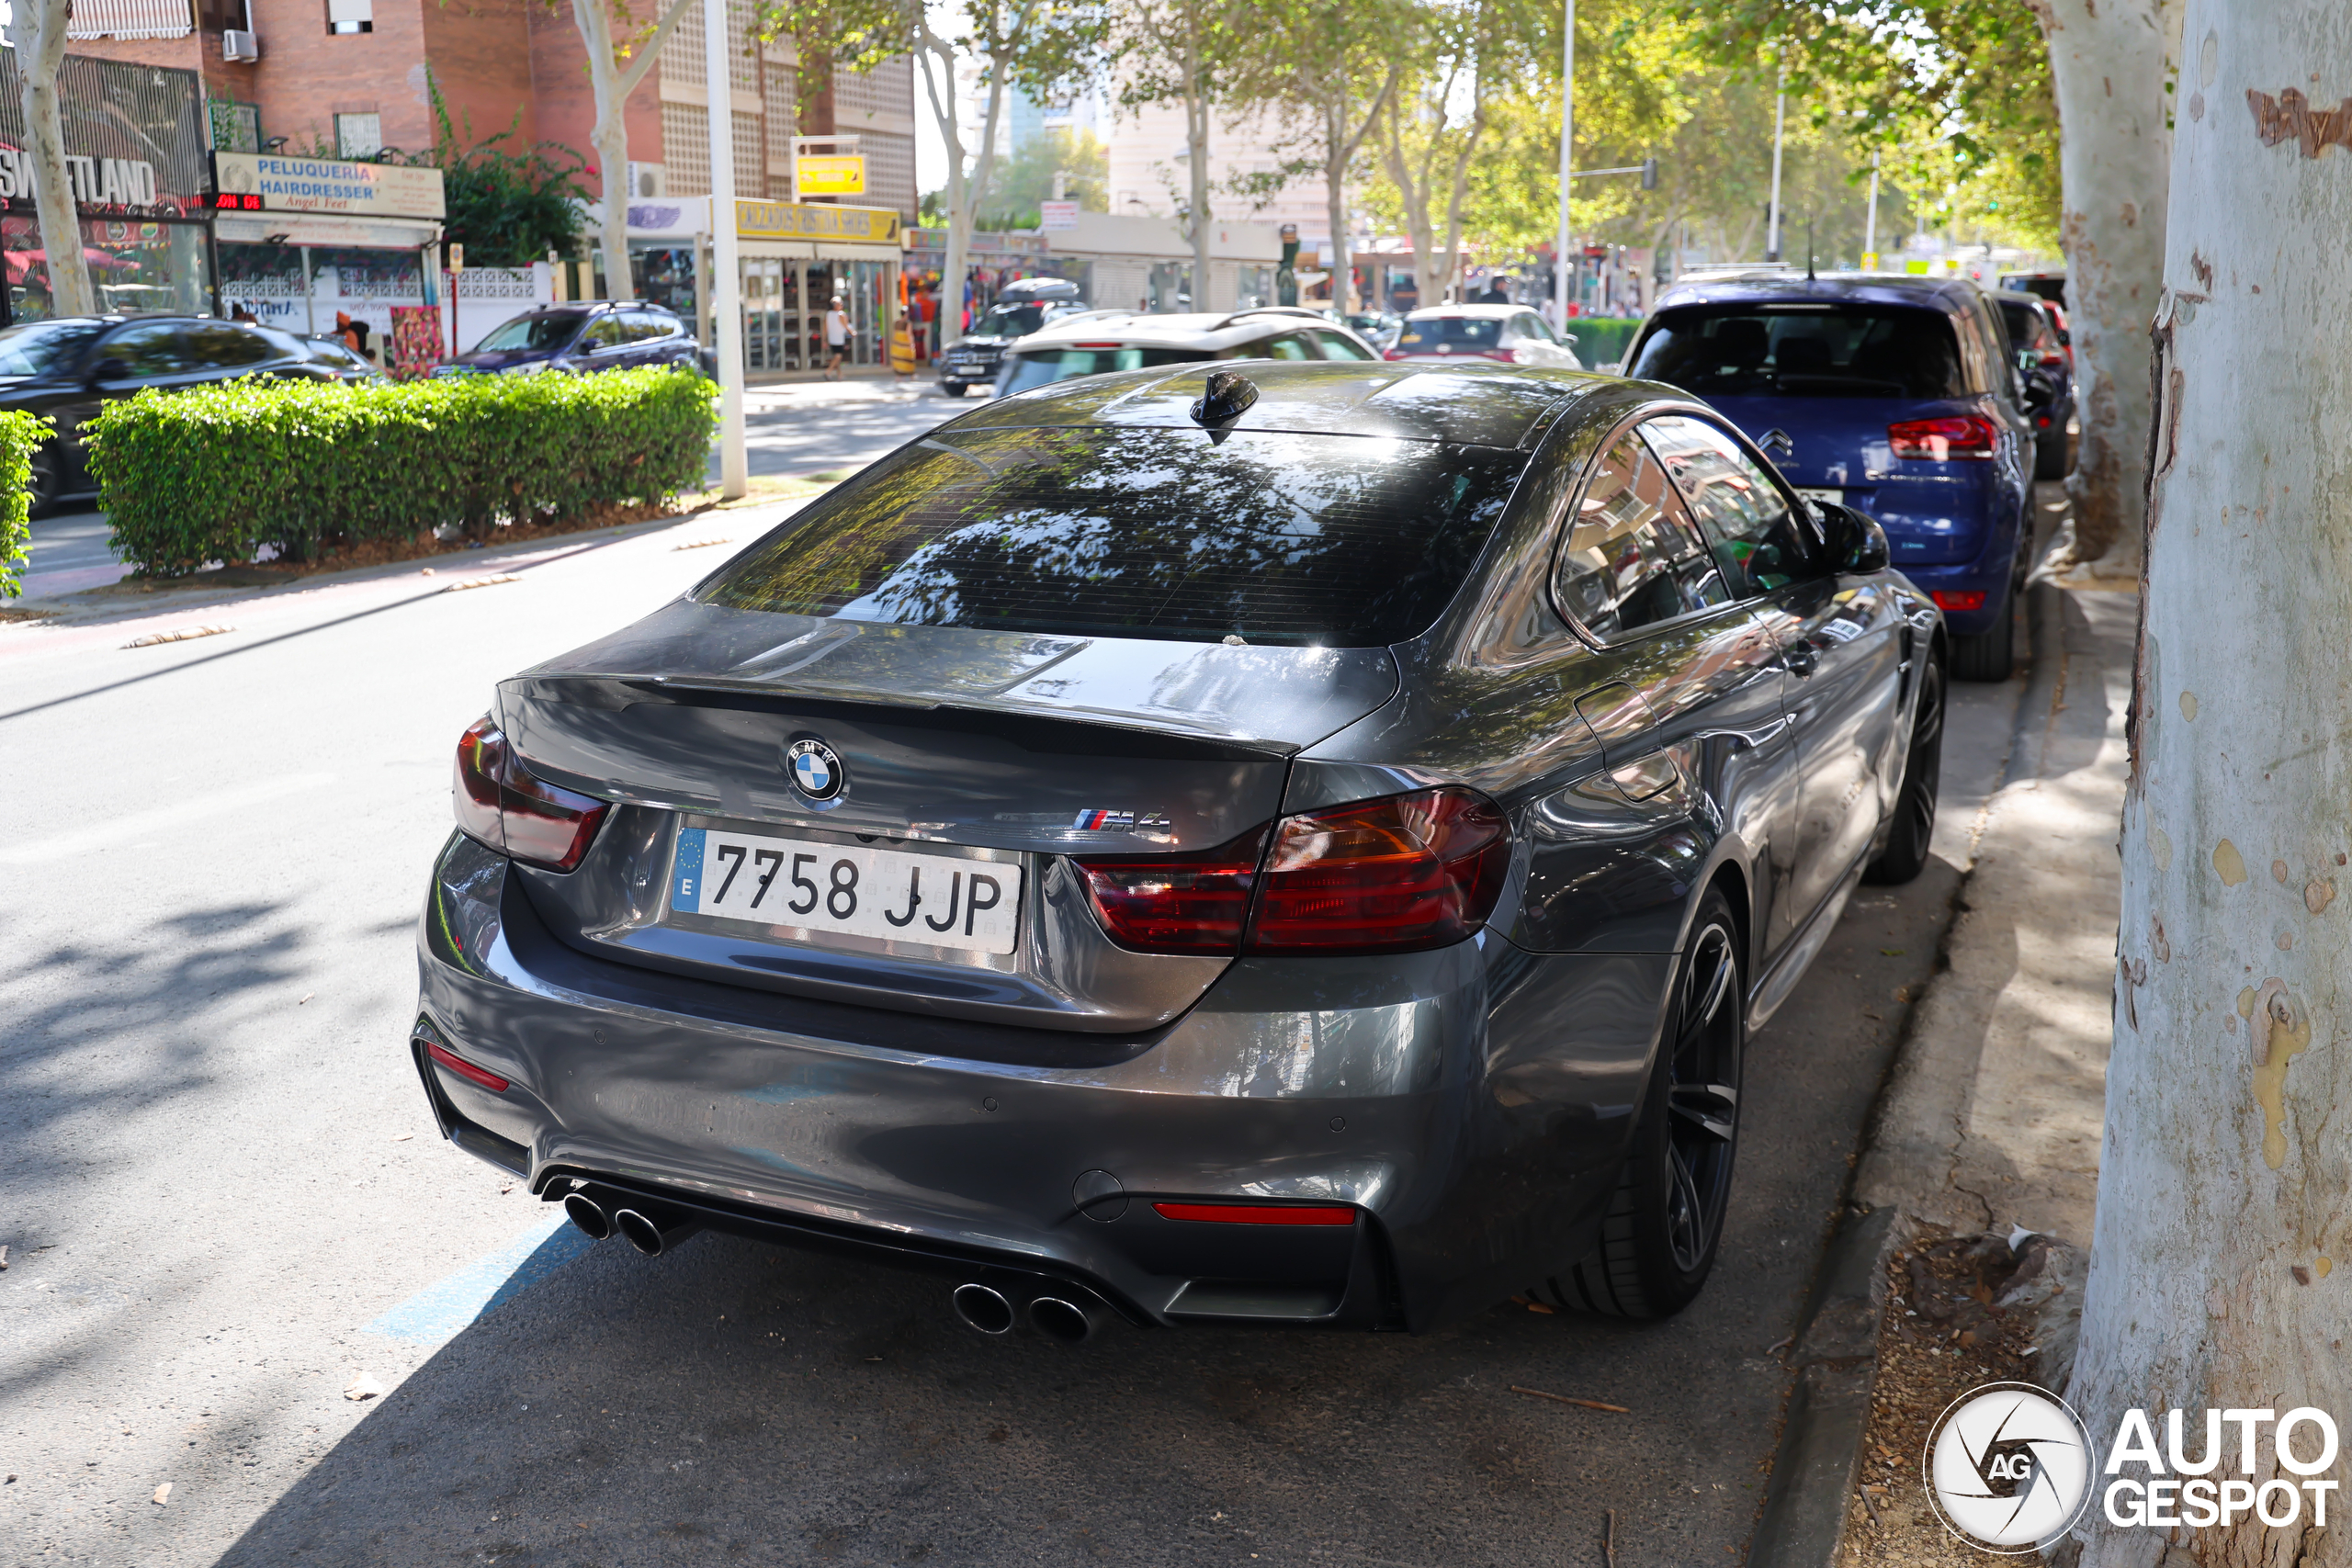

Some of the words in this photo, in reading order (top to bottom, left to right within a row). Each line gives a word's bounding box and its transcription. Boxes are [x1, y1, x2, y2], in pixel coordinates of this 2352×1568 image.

[259, 180, 374, 199] HAIRDRESSER
[285, 196, 319, 210] Angel
[324, 197, 348, 209] Feet
[738, 203, 794, 231] CALZADOS
[789, 741, 835, 764] BMW
[1099, 809, 1170, 835] M4
[681, 878, 693, 896] E
[713, 844, 859, 920] 7758
[884, 866, 1001, 937] JJP
